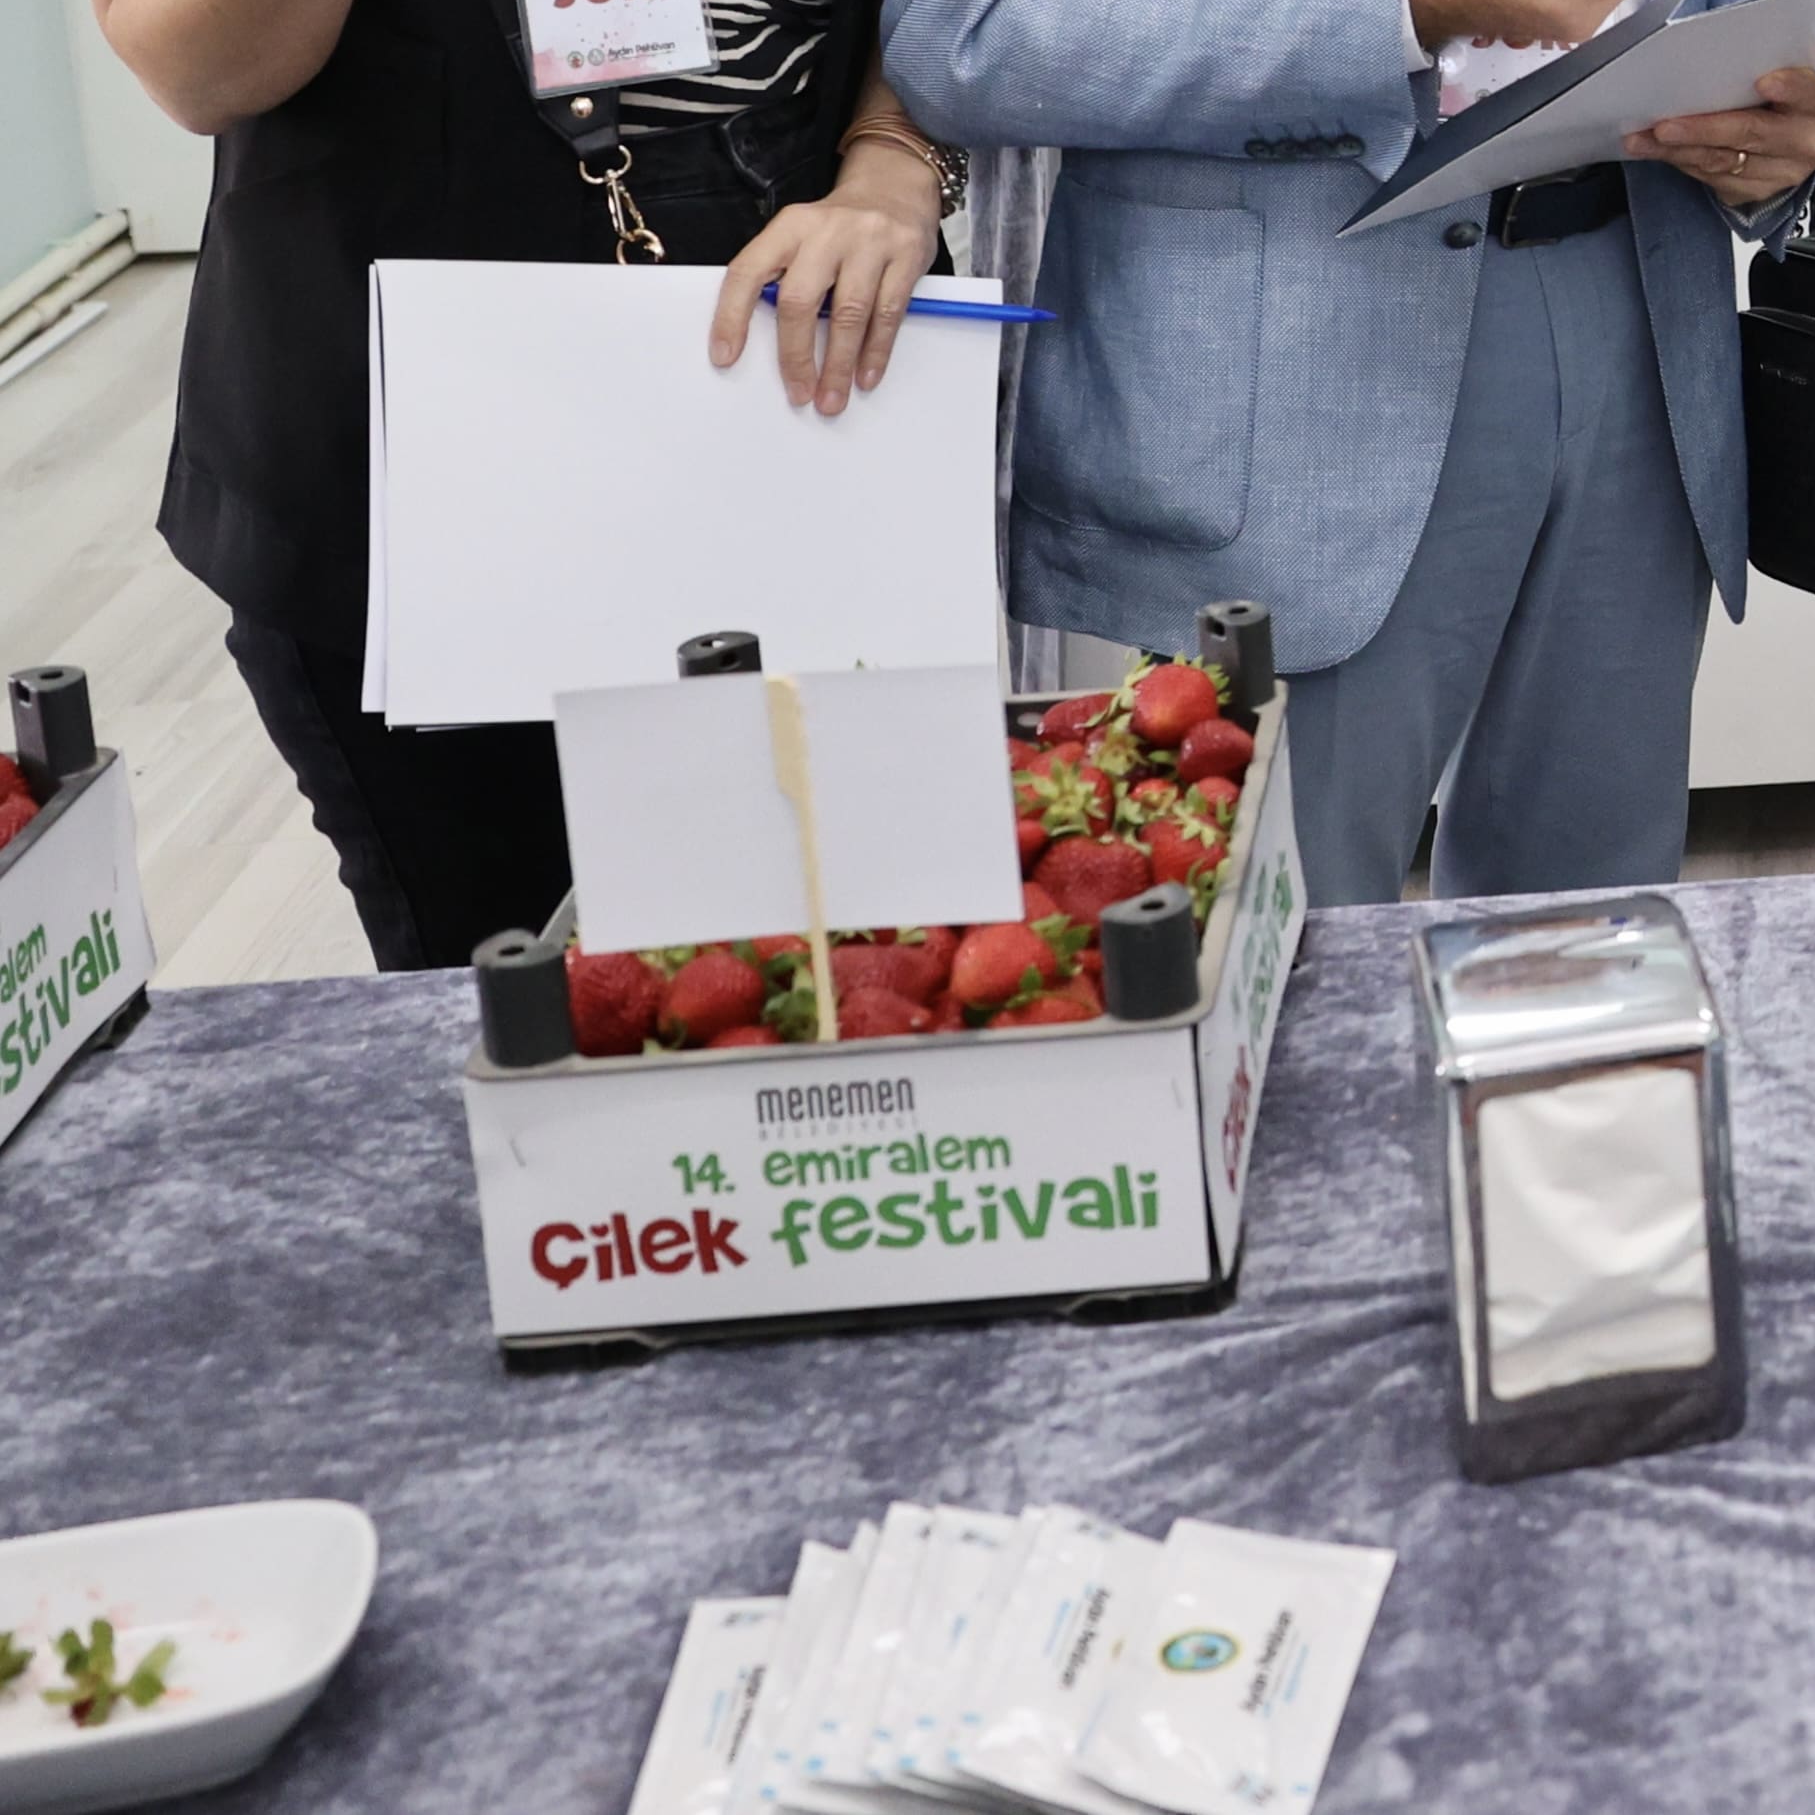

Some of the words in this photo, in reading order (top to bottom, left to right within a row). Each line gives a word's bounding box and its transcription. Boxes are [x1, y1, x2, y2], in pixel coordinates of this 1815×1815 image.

[756, 1076, 915, 1125] menemen
[672, 1152, 736, 1197] 14.
[763, 1132, 1011, 1187] emiralem
[530, 1208, 749, 1291] Çilek
[771, 1164, 1160, 1268] festivali
